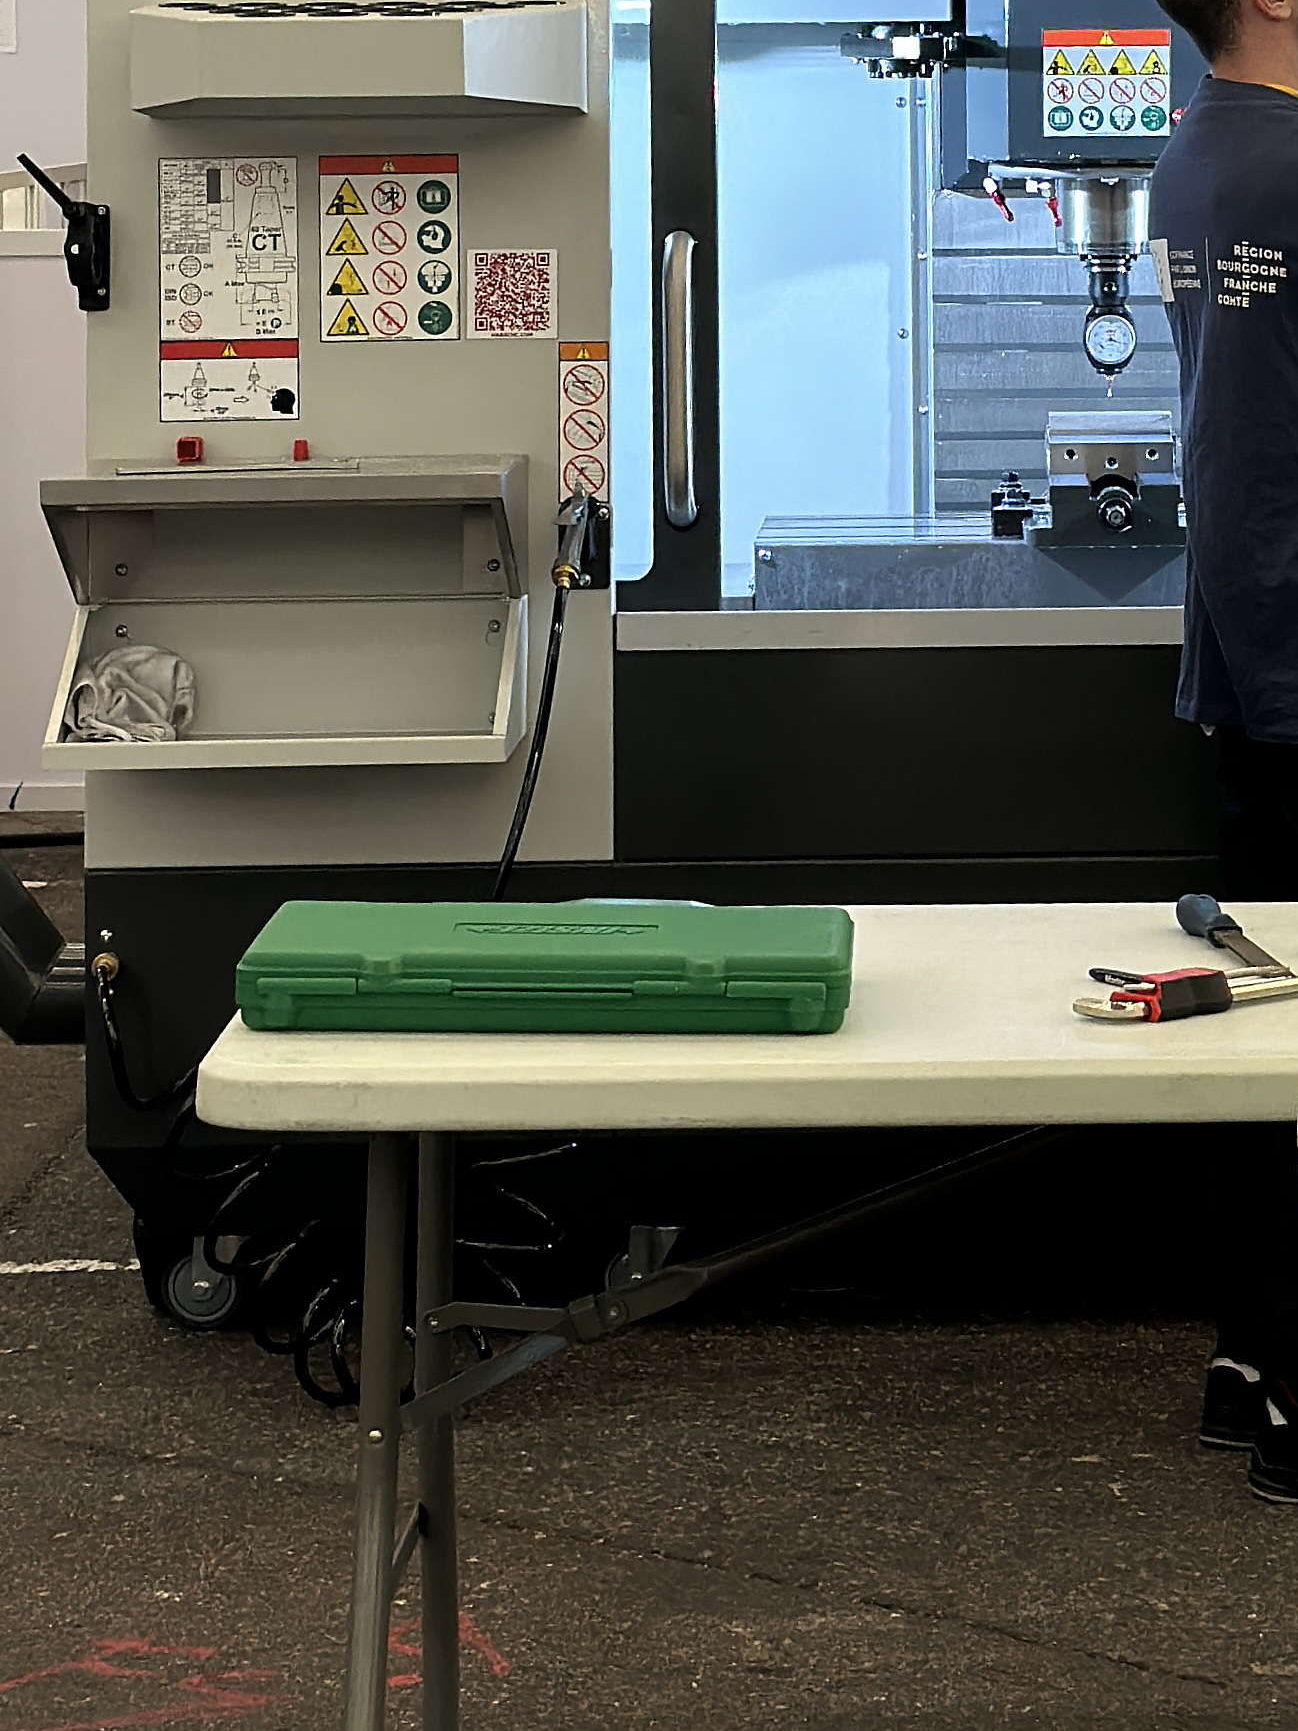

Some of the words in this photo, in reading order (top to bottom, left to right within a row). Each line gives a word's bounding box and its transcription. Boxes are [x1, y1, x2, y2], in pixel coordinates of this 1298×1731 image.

[252, 233, 282, 251] CT
[1216, 259, 1287, 278] BOURGOGNE
[1223, 277, 1277, 294] FRANCHE
